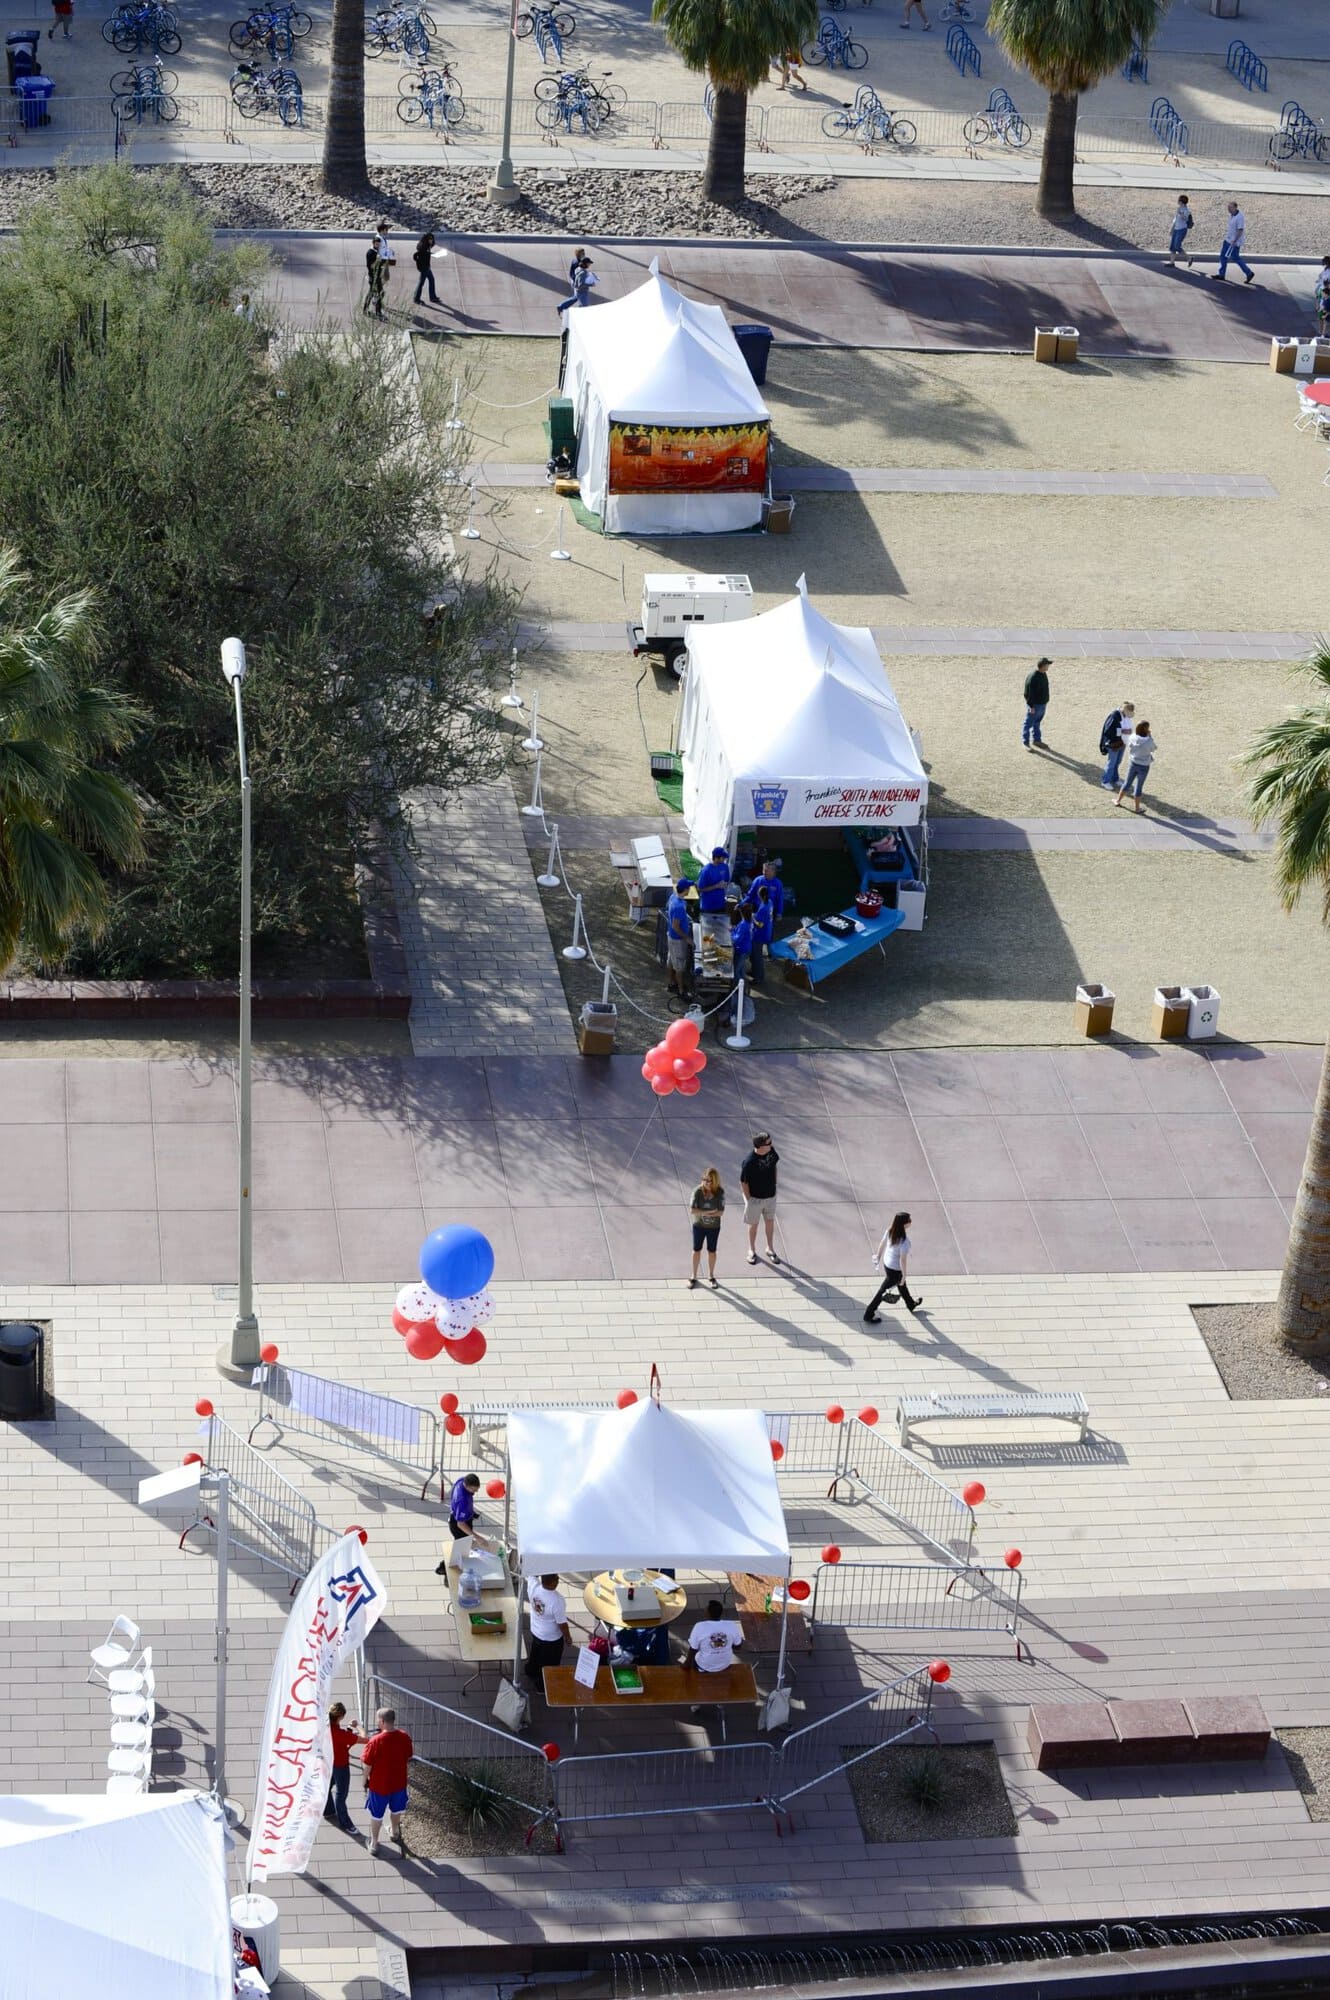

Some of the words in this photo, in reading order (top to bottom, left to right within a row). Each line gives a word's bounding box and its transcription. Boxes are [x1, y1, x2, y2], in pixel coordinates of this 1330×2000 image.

[840, 788, 866, 802] SOUTH
[869, 788, 920, 802] PHILADELPHIA
[814, 804, 851, 818] CHEESE
[854, 804, 896, 817] STEAKS
